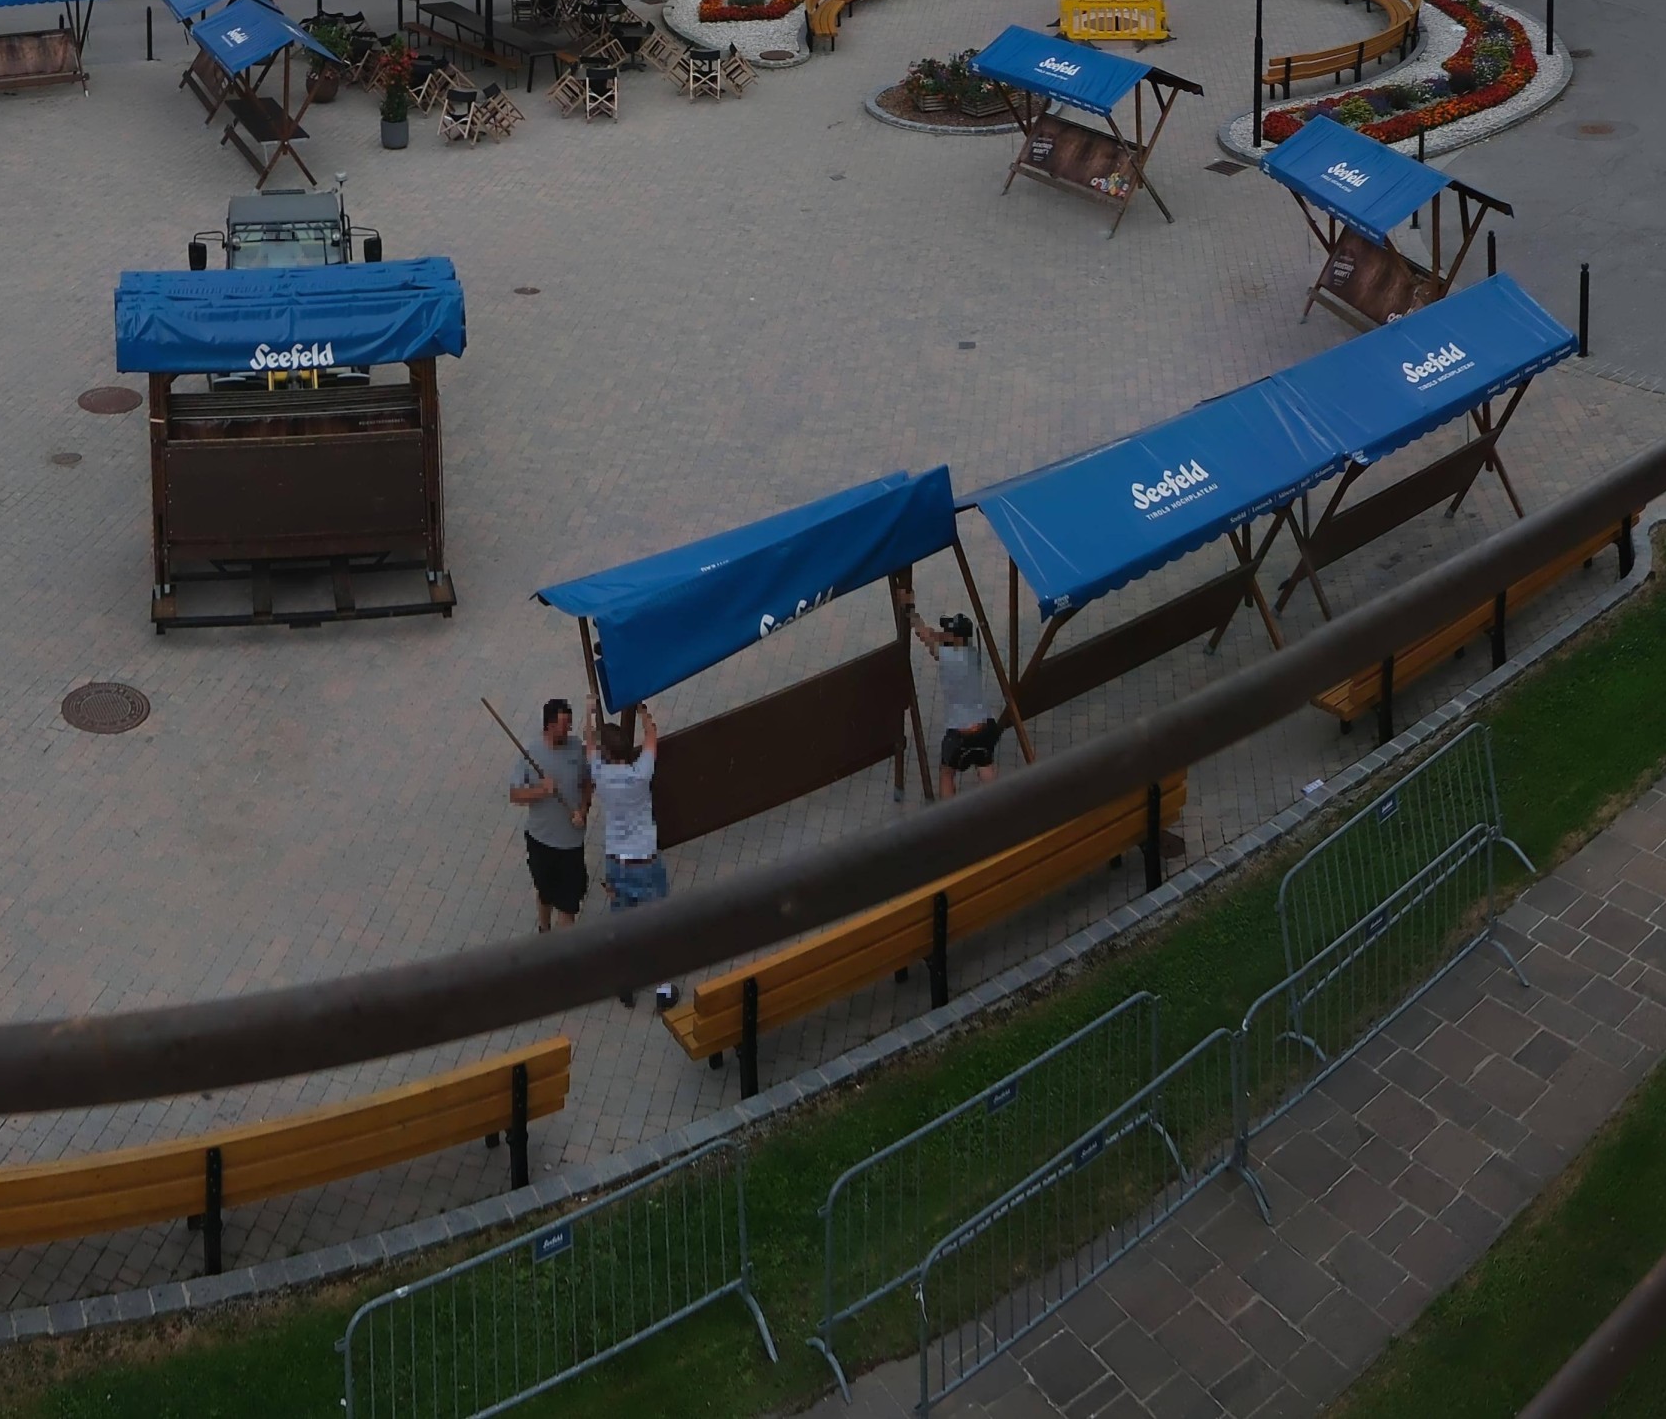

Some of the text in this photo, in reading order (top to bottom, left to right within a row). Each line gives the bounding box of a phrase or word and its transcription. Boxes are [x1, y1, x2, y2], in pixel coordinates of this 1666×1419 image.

[250, 341, 335, 371] Seefeld
[1402, 343, 1467, 384] Seefeld
[1131, 459, 1209, 510] Seefeld
[1145, 482, 1219, 522] TIROLS HOCHPLATEAU
